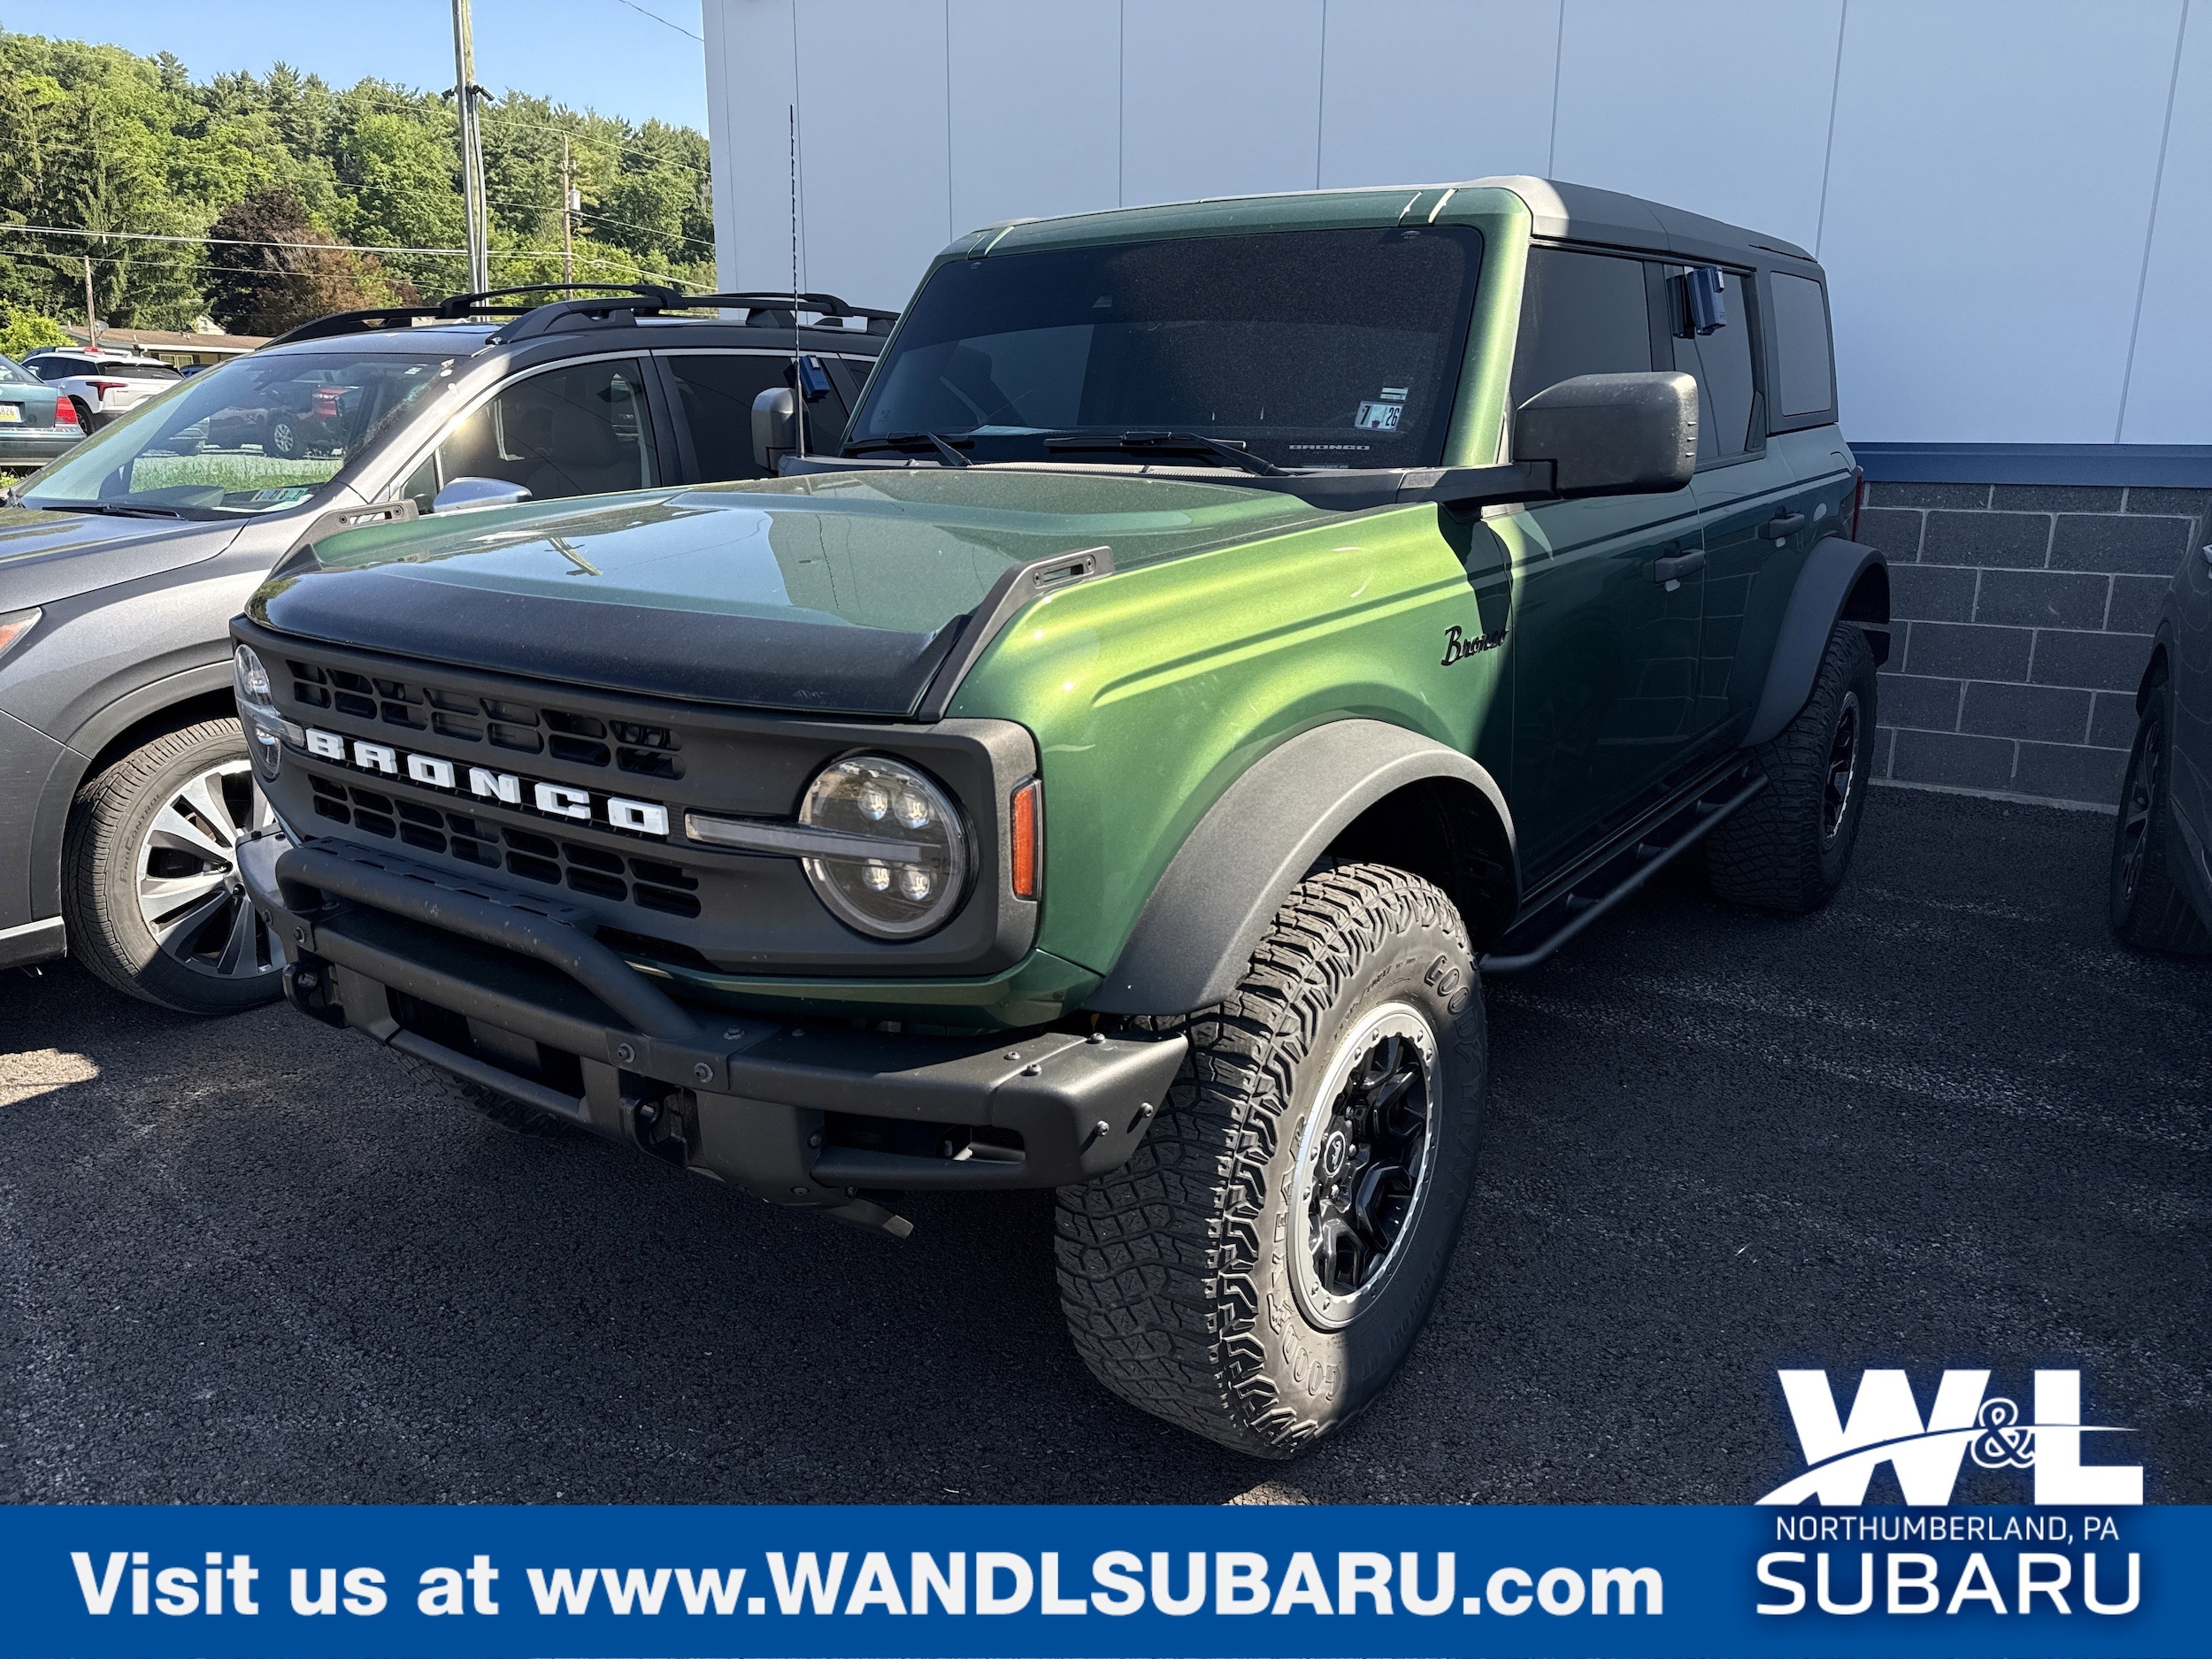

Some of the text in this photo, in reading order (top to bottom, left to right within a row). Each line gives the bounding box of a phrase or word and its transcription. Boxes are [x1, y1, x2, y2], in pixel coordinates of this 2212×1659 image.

[1385, 407, 1400, 427] 26
[1440, 626, 1509, 666] Bronco
[305, 727, 670, 835] BRONCO
